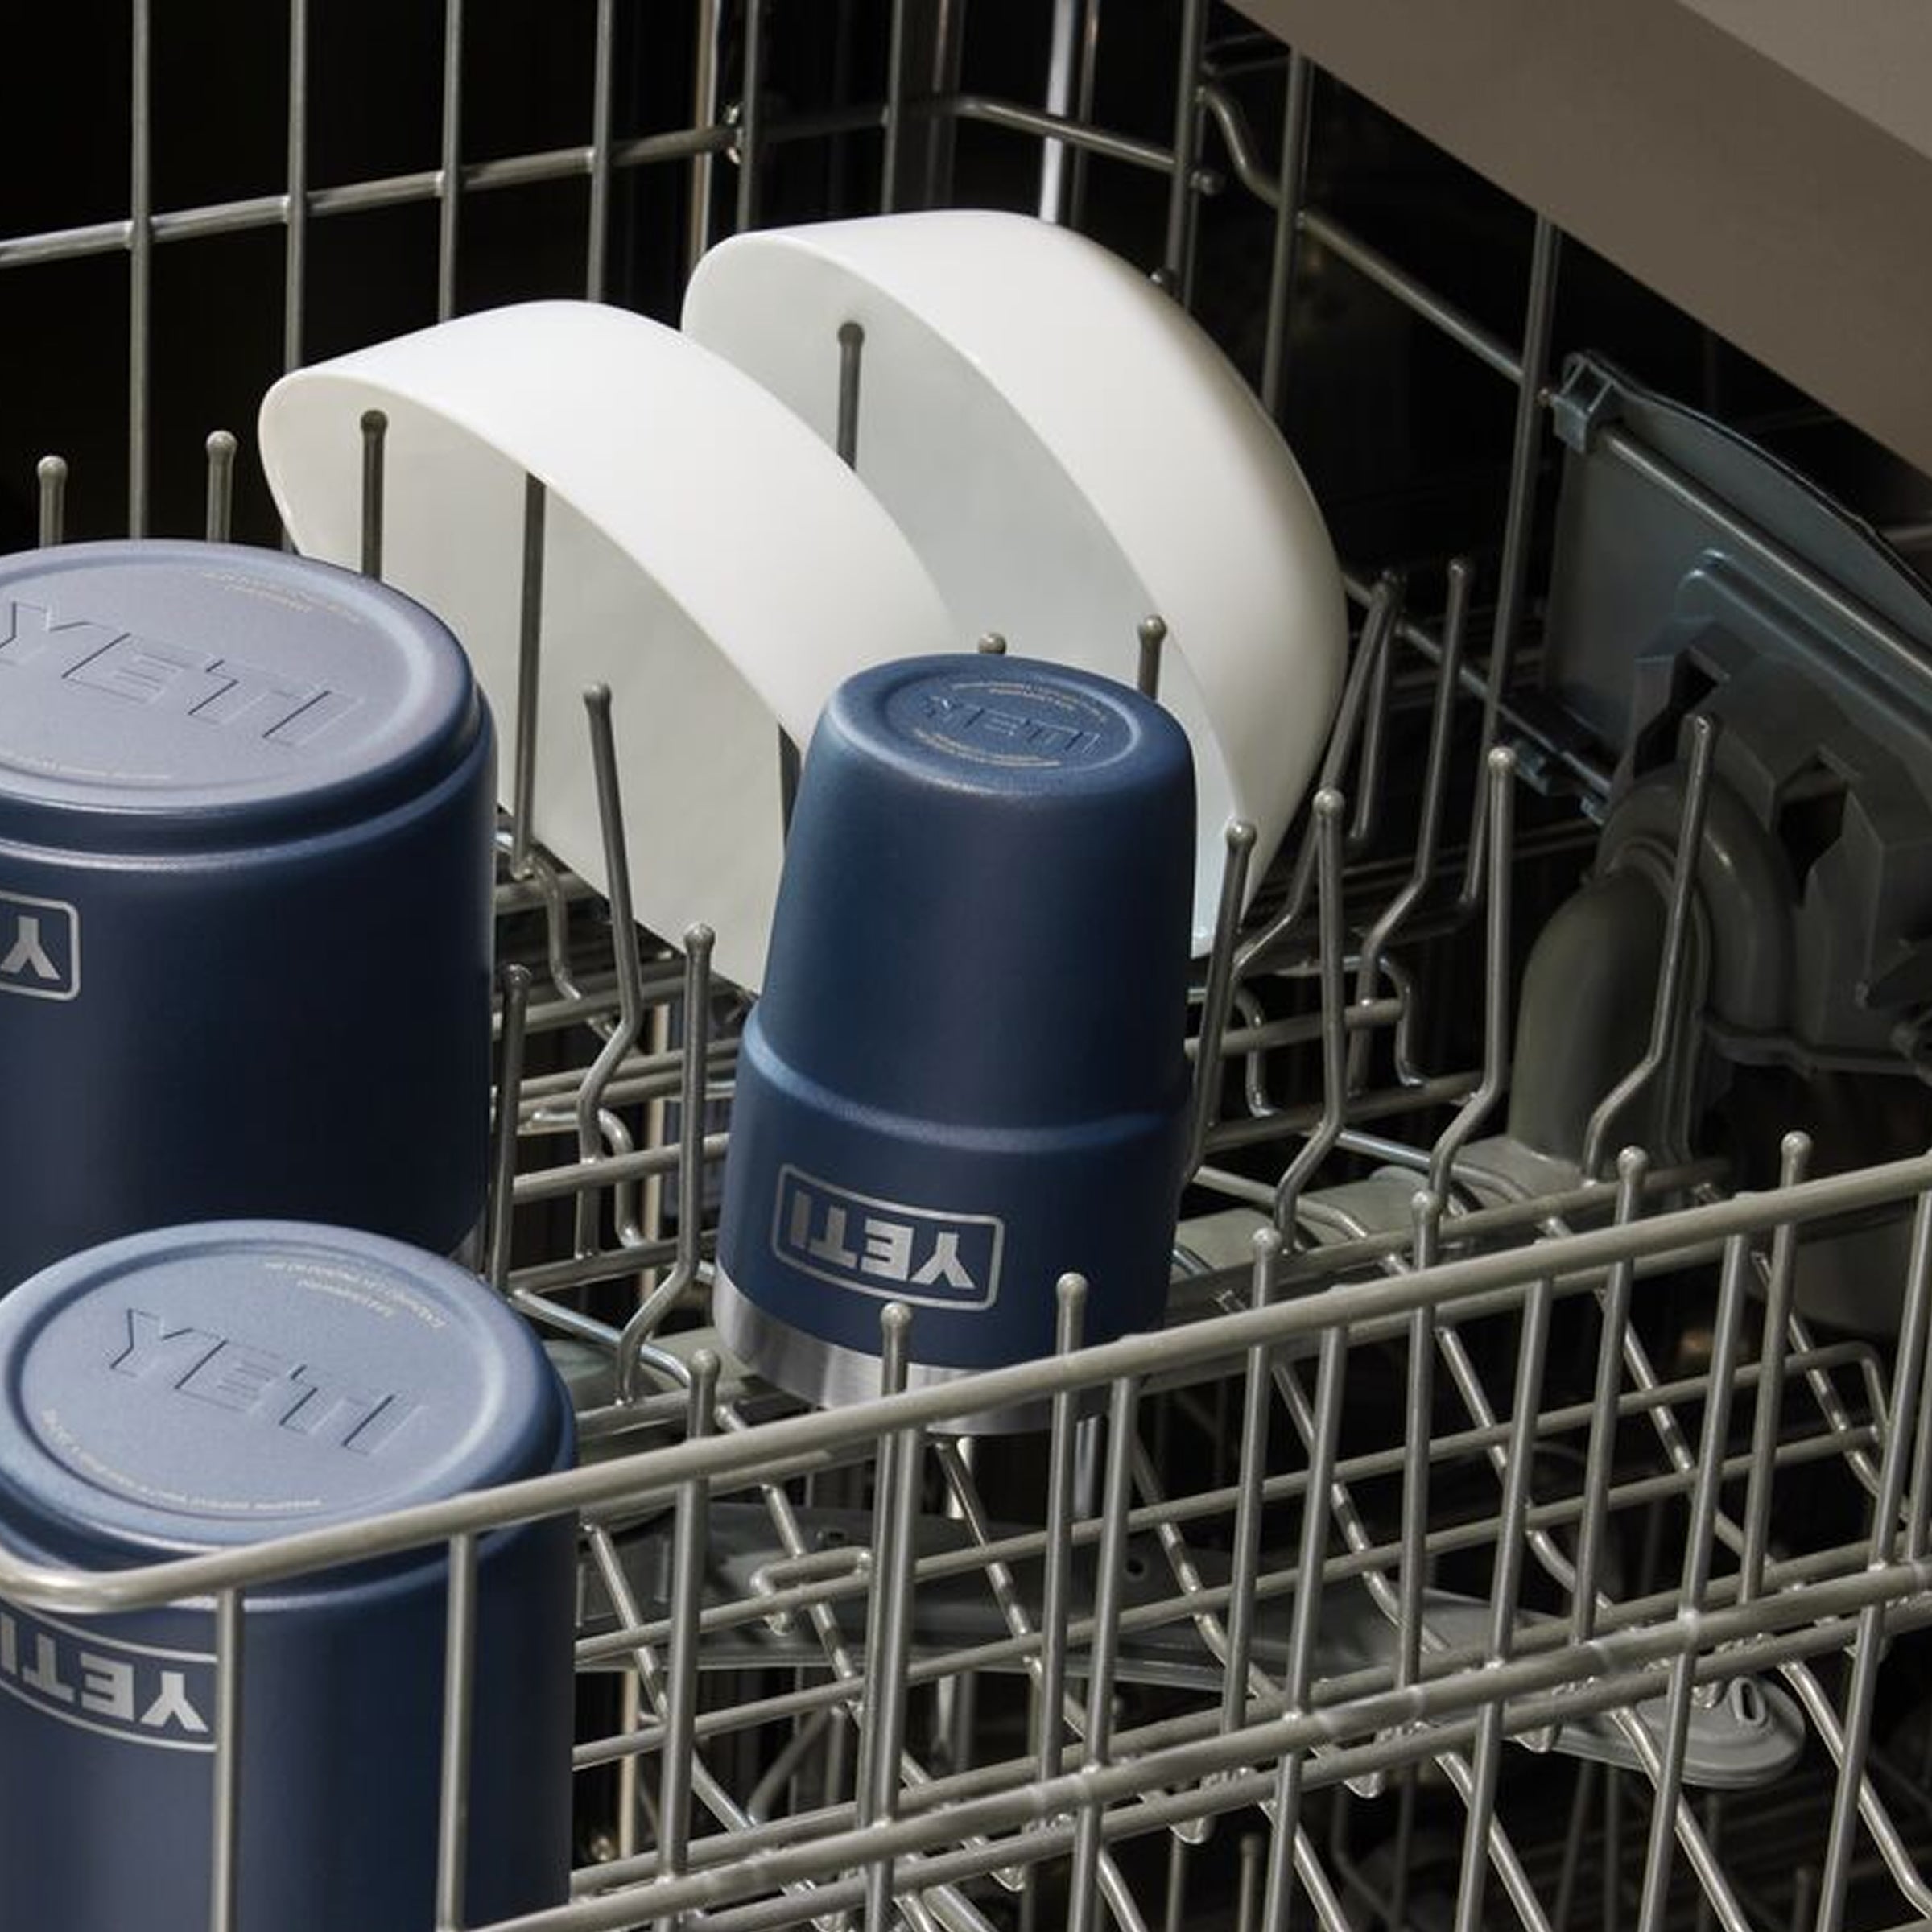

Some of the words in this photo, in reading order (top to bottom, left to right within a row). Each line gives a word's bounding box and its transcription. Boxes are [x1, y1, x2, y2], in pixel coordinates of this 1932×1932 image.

[0, 601, 366, 748] YETI
[920, 693, 1101, 756] YETI
[790, 1190, 976, 1290] YETI
[107, 1307, 422, 1456] YETI
[0, 1611, 209, 1733] YETI
